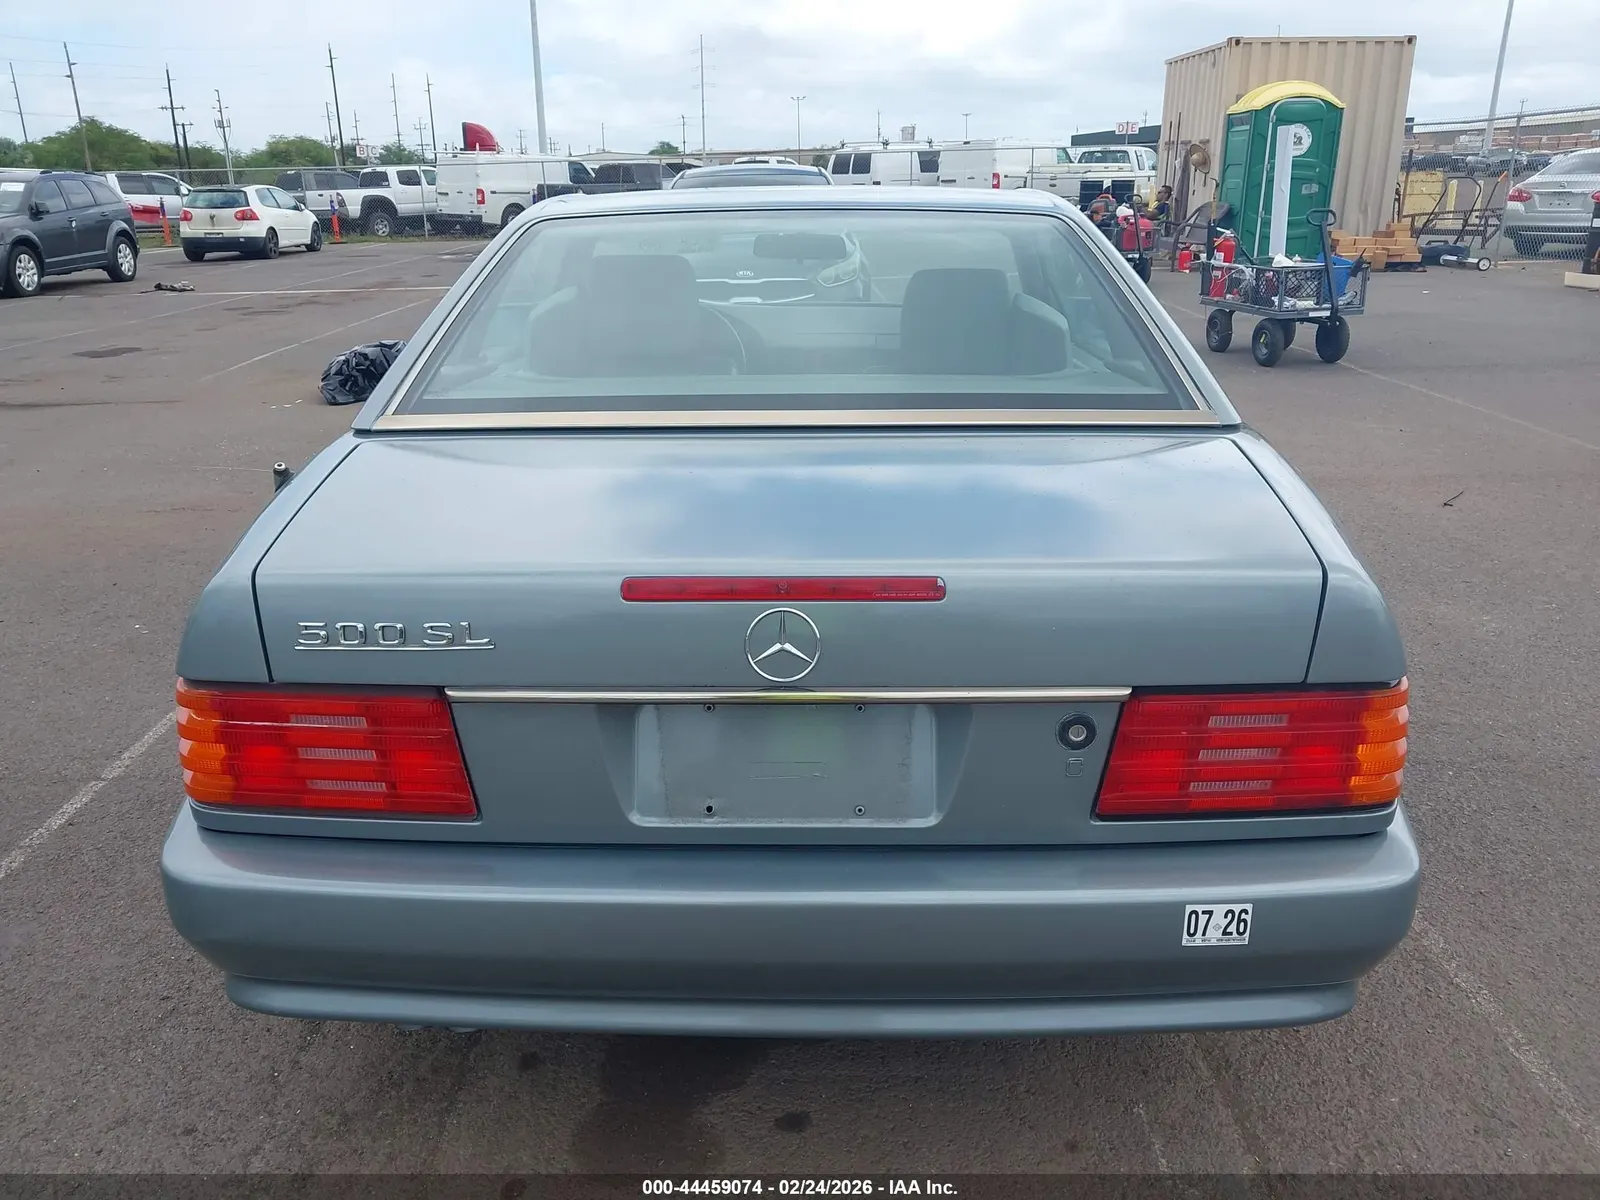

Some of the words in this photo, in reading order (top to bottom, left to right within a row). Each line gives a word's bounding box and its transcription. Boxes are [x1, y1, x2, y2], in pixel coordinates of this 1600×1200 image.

[1118, 123, 1125, 133] D
[1130, 123, 1137, 133] E
[358, 146, 365, 156] B
[370, 146, 377, 156] C
[297, 621, 406, 645] 500
[422, 621, 492, 645] SL
[1186, 909, 1214, 938] 07
[1221, 908, 1249, 937] 26
